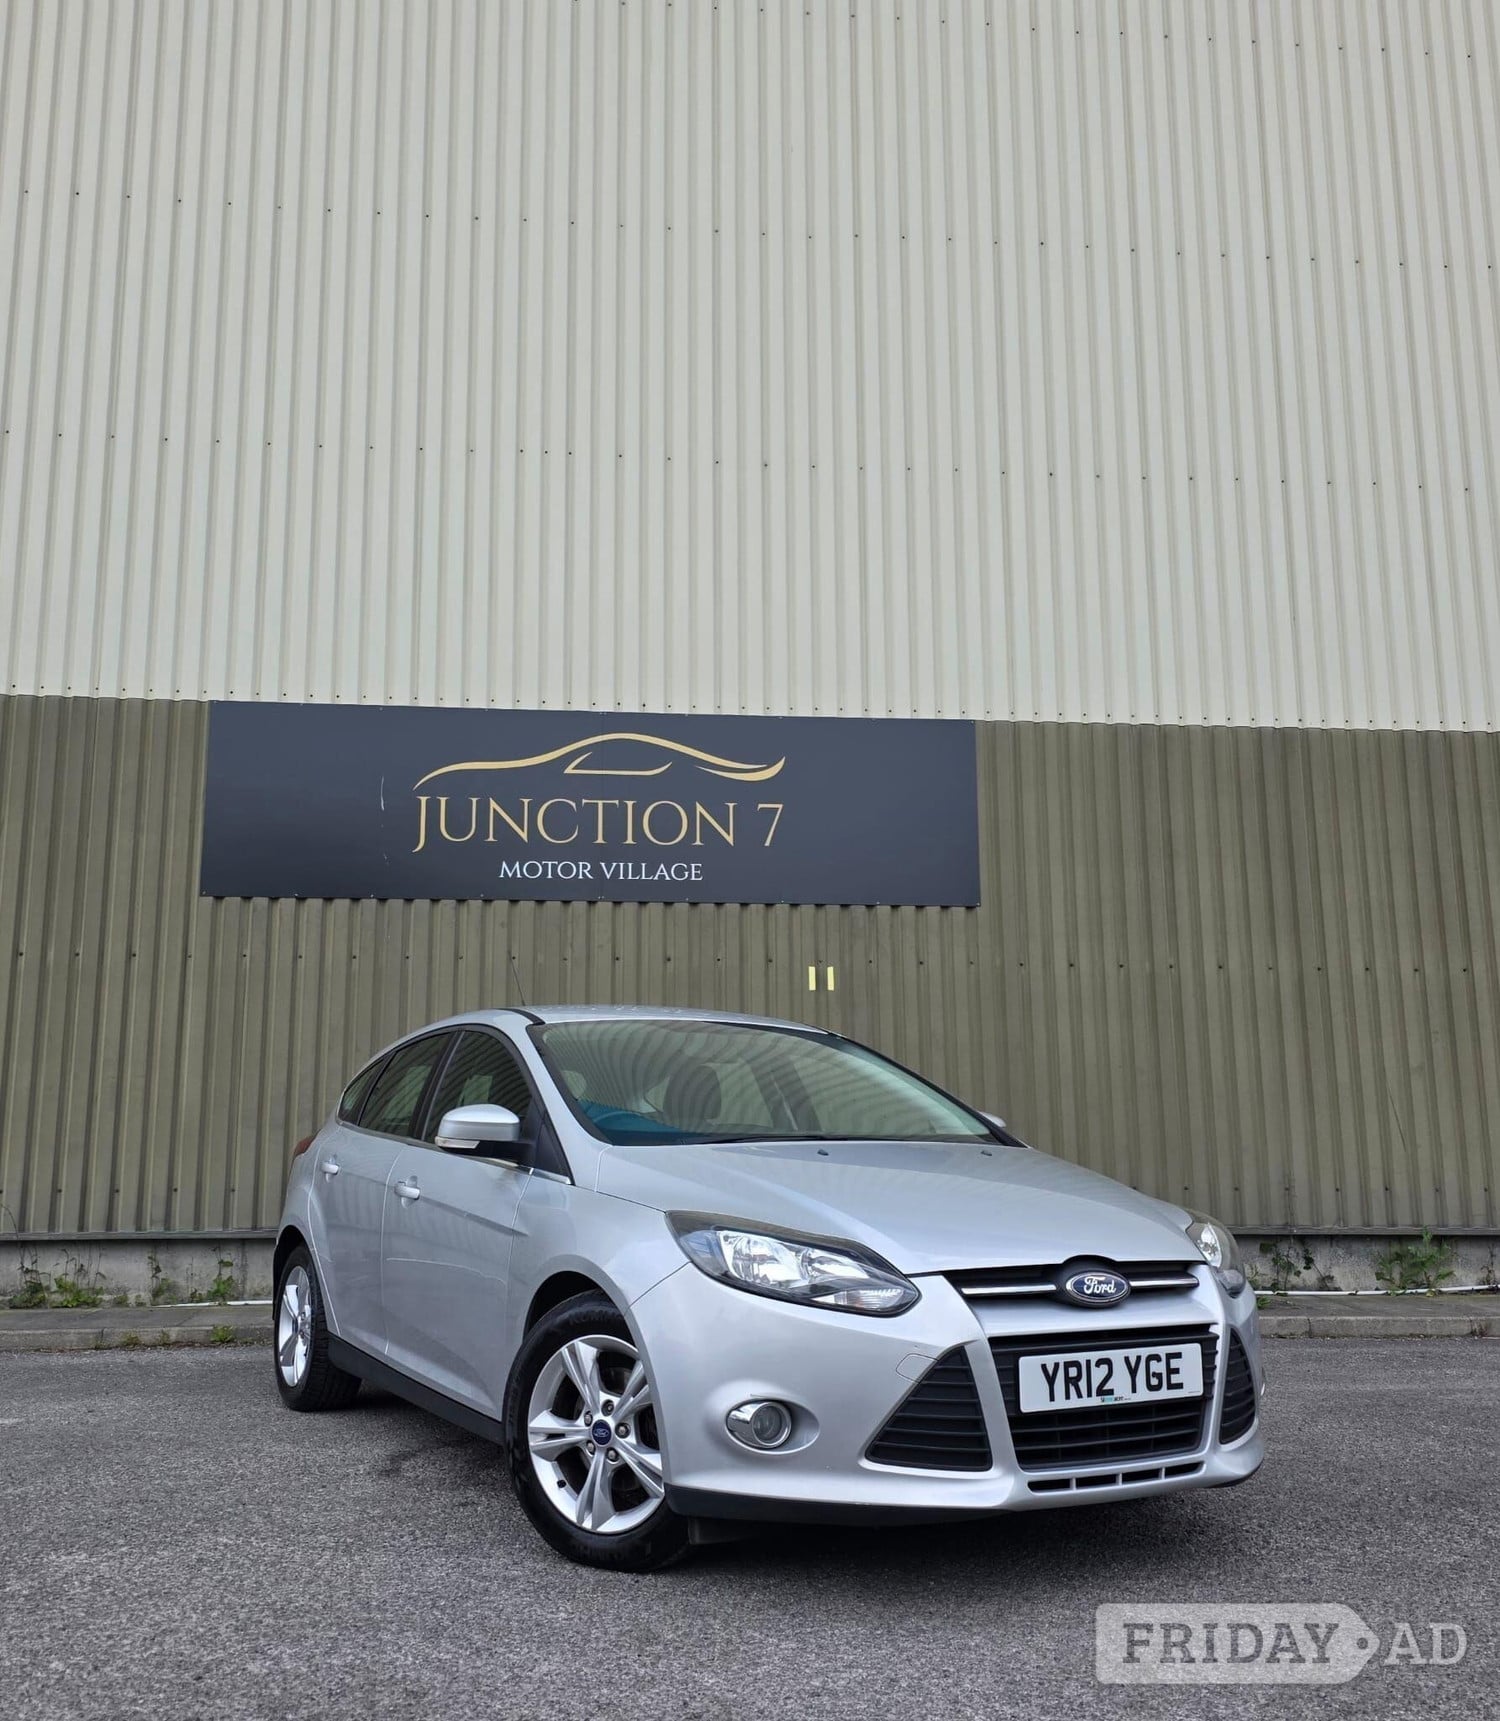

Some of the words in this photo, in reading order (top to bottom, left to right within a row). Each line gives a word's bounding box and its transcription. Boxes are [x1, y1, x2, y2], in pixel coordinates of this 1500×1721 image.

[412, 796, 738, 852] JUNCTION
[757, 803, 784, 847] 7
[499, 860, 593, 880] MOTOR
[600, 862, 703, 881] VILLAGE
[1083, 1276, 1117, 1294] Ford
[1040, 1357, 1115, 1402] YR12
[1123, 1351, 1184, 1394] YGE
